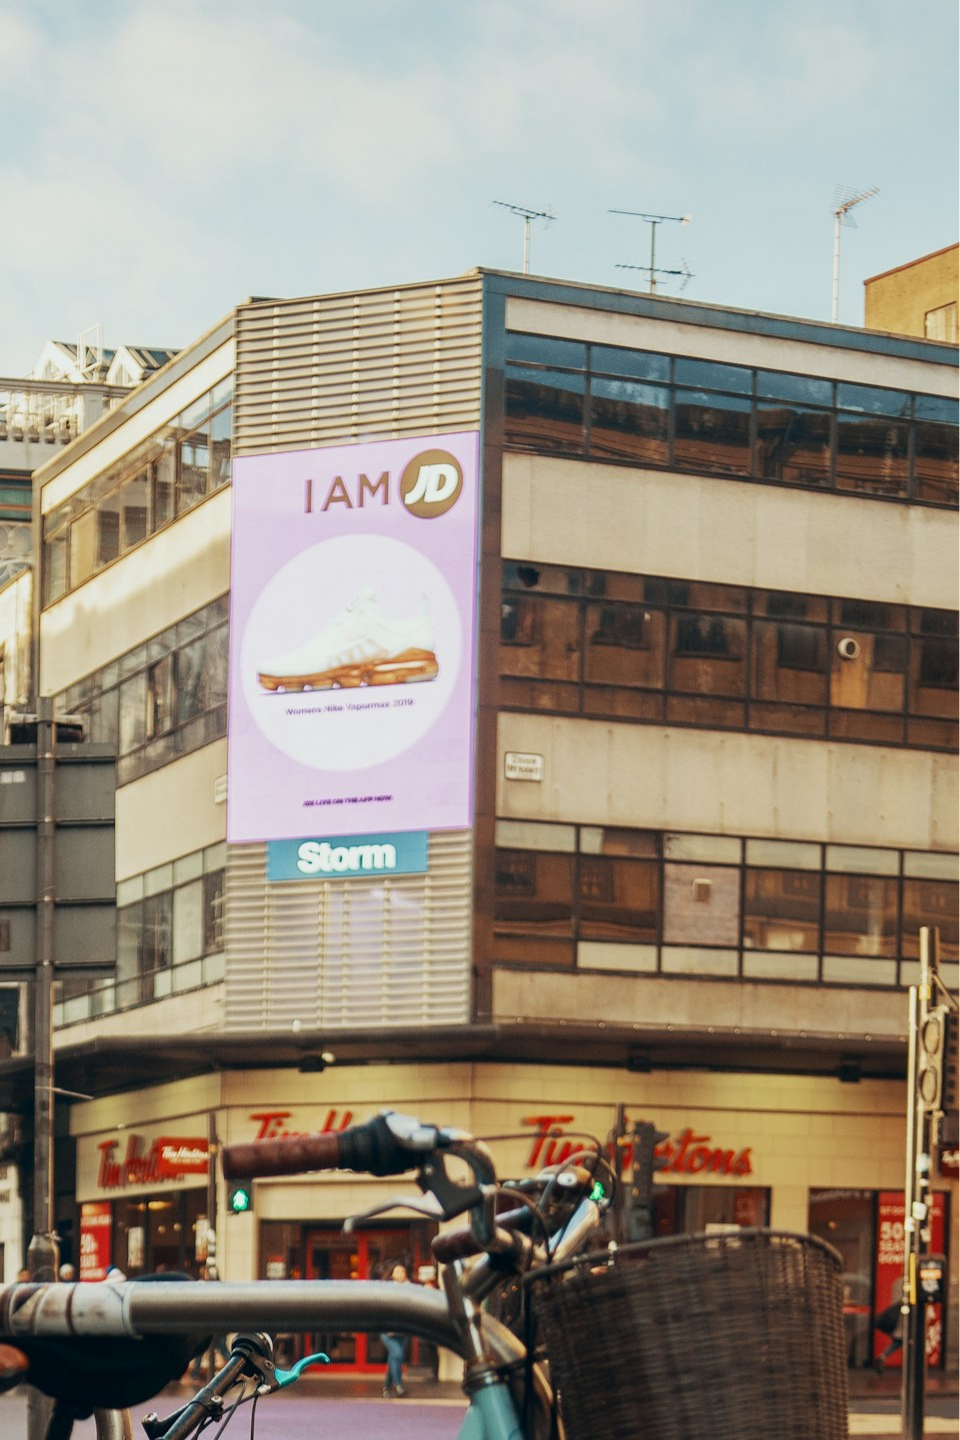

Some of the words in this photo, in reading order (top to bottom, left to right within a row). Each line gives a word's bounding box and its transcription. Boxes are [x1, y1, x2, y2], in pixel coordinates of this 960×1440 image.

[305, 479, 313, 514] I
[320, 470, 390, 512] AM
[404, 462, 460, 506] JD
[296, 841, 397, 874] Storm
